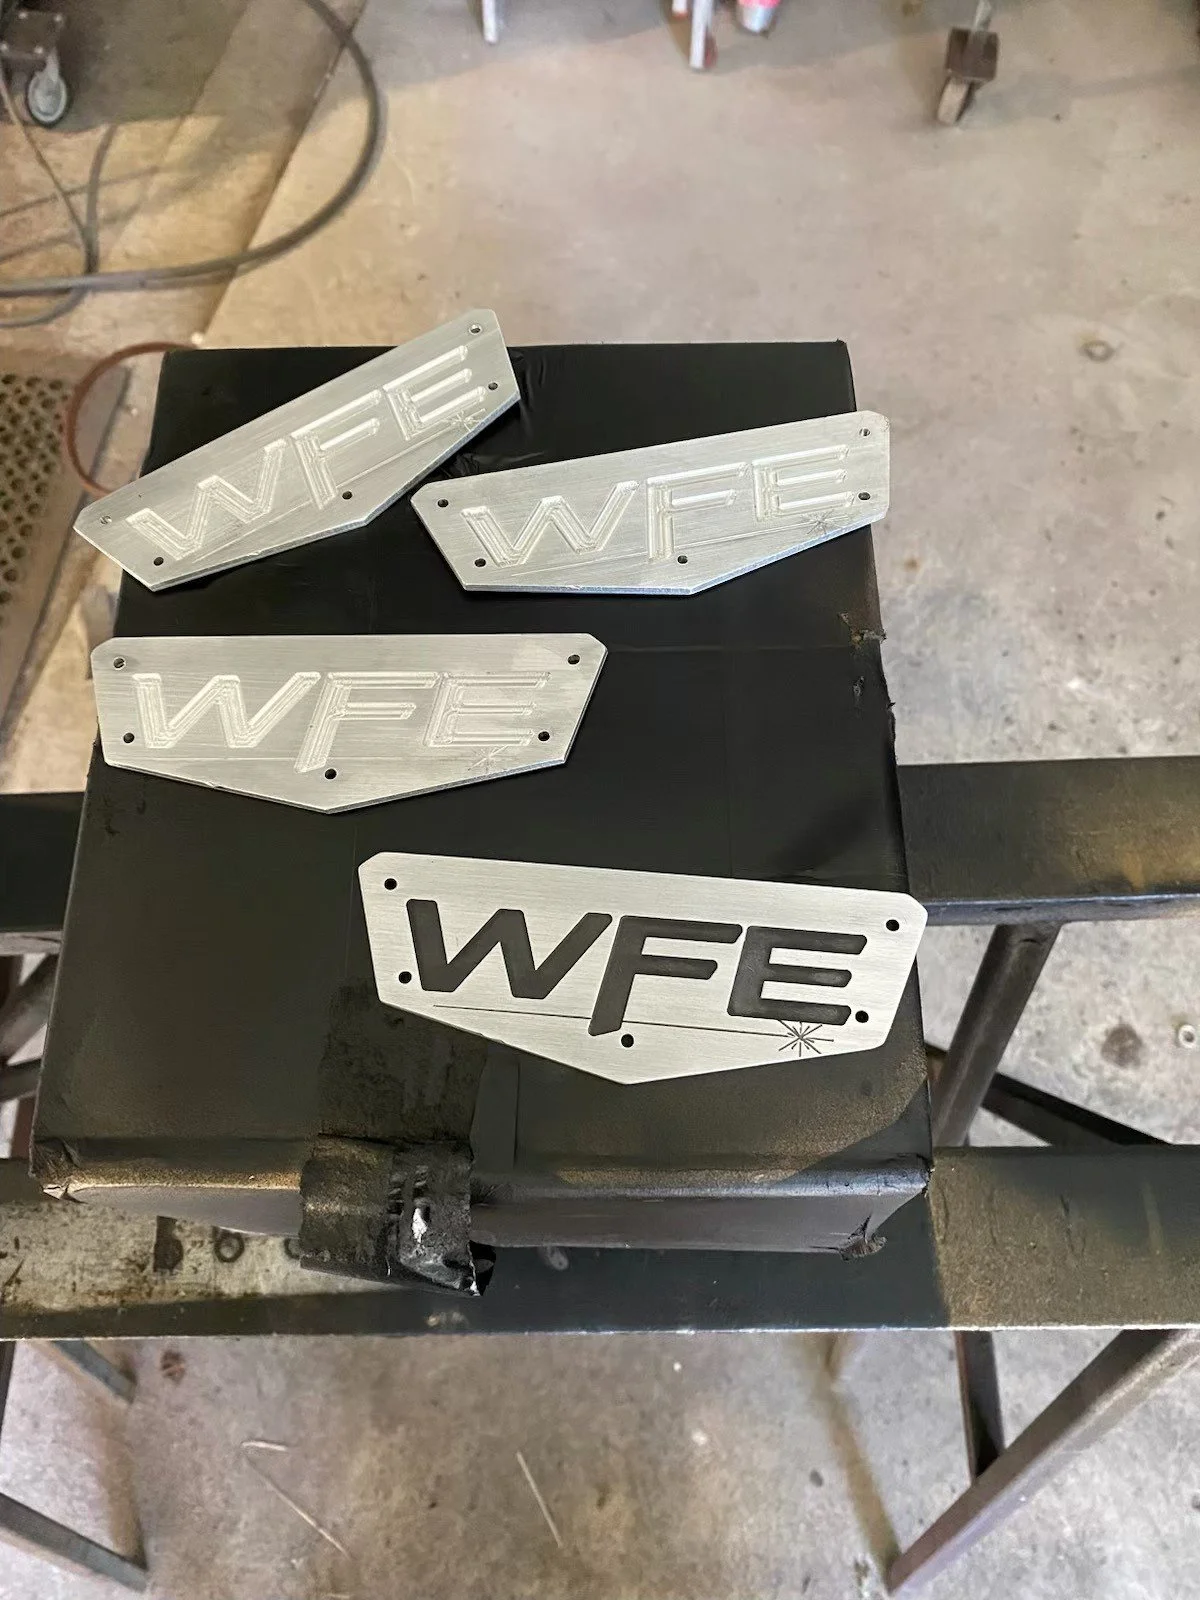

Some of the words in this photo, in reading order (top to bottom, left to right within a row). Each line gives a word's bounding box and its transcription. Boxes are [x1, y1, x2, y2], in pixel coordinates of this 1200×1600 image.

[125, 345, 487, 560] WFE
[460, 445, 855, 567] WFE
[131, 671, 552, 773] WFE
[406, 898, 868, 1036] WFE
